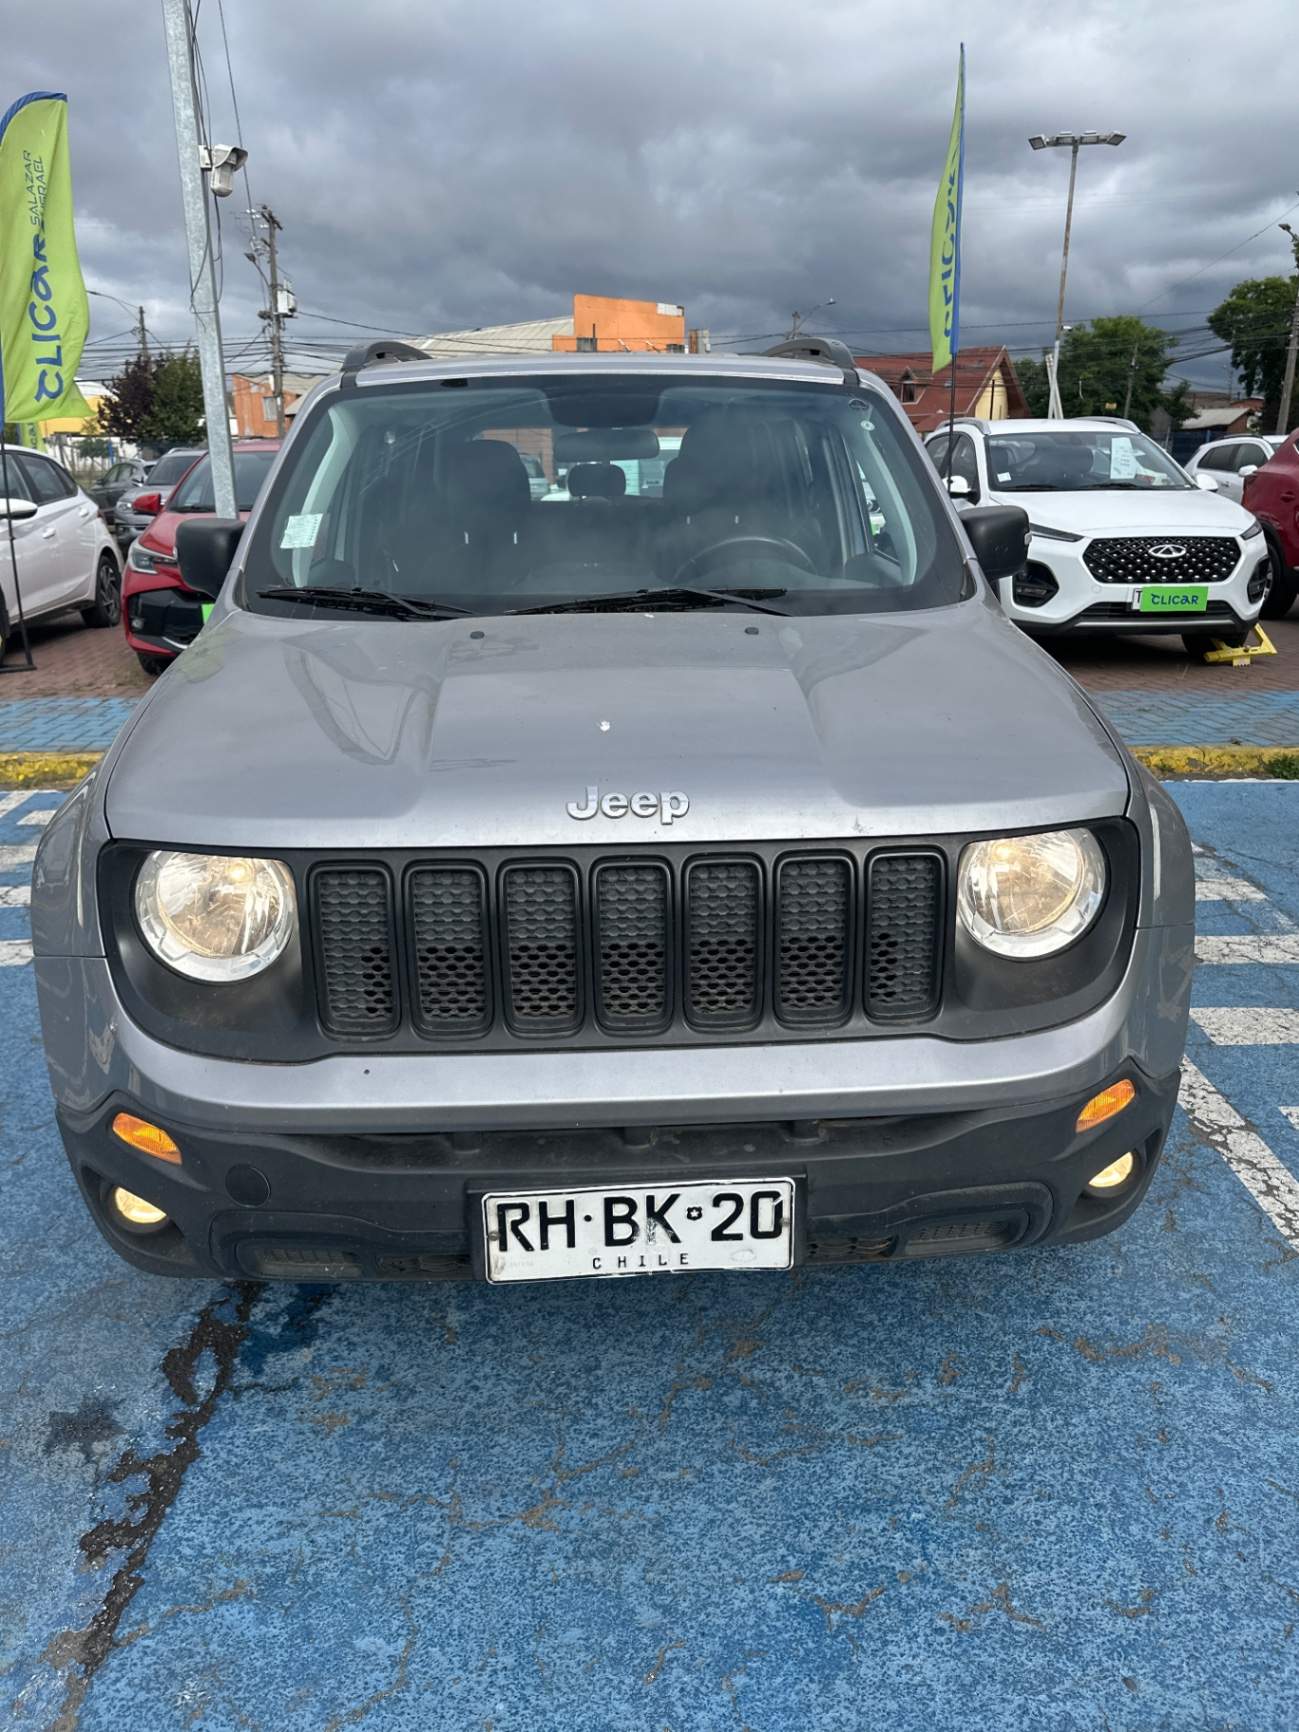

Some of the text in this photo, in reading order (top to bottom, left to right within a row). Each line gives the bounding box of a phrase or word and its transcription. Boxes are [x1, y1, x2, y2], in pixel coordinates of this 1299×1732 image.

[23, 150, 40, 225] SALAZAR
[566, 785, 690, 826] Jeep
[592, 1252, 689, 1270] CHILE
